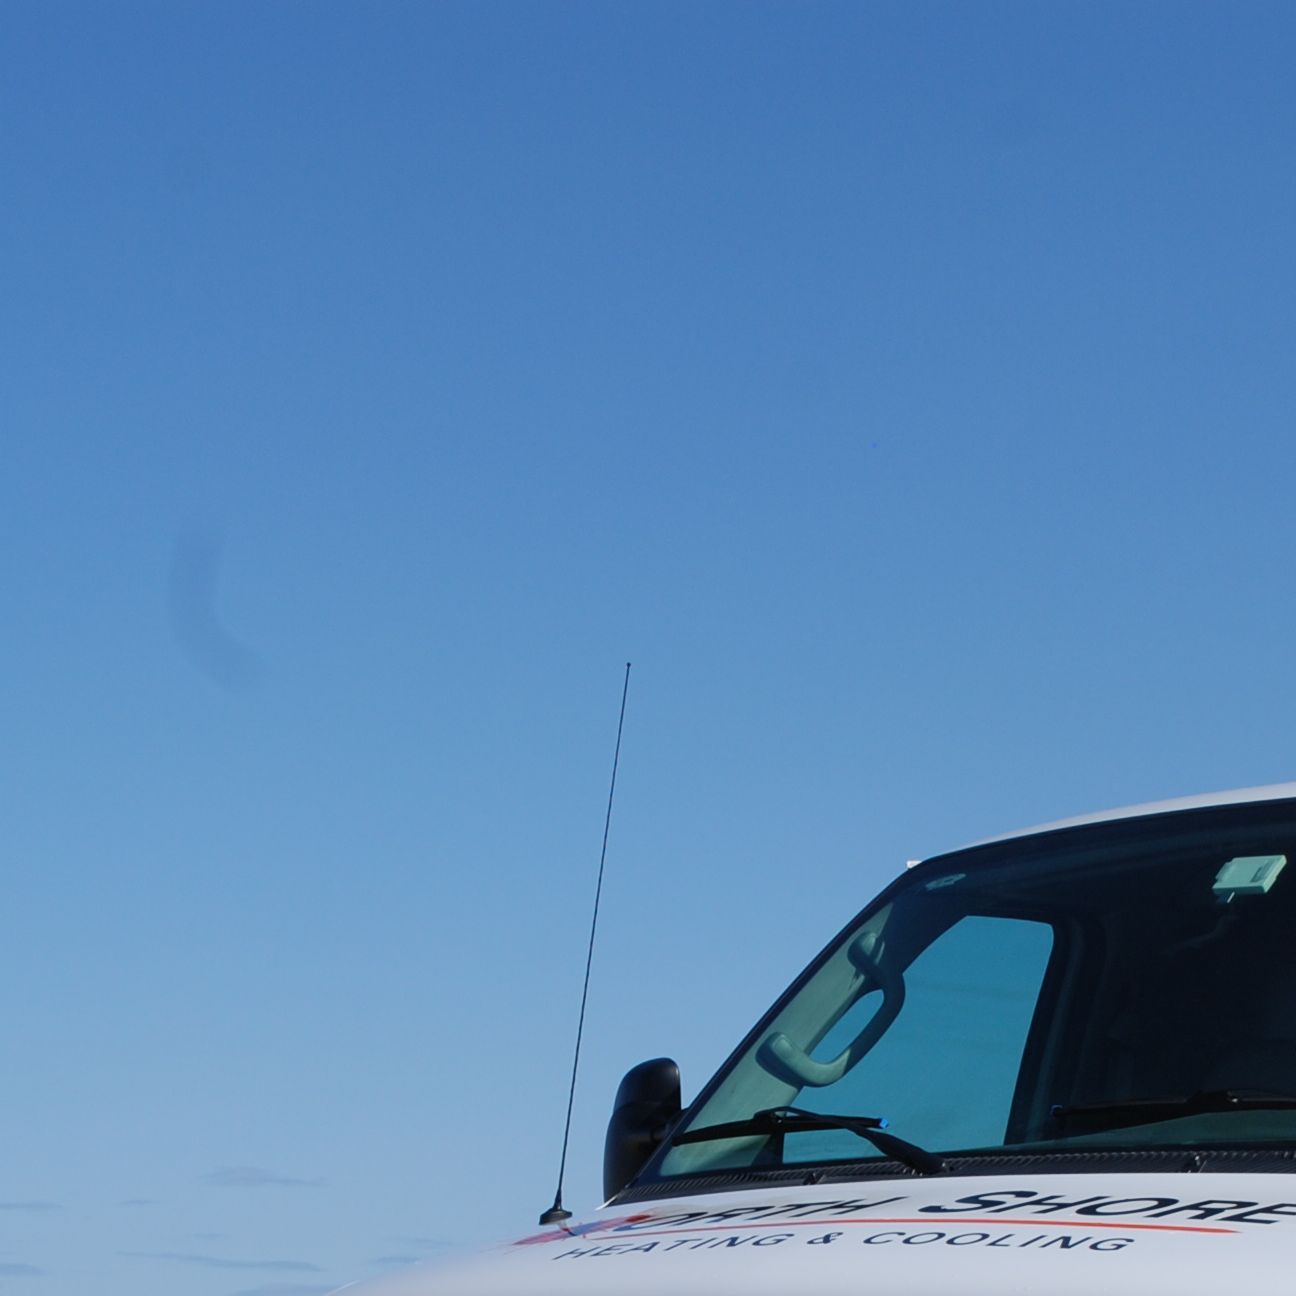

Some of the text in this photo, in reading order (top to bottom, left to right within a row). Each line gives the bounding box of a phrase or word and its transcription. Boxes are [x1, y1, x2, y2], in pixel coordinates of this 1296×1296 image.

[553, 1231, 1136, 1260] HEATING & COOLING
